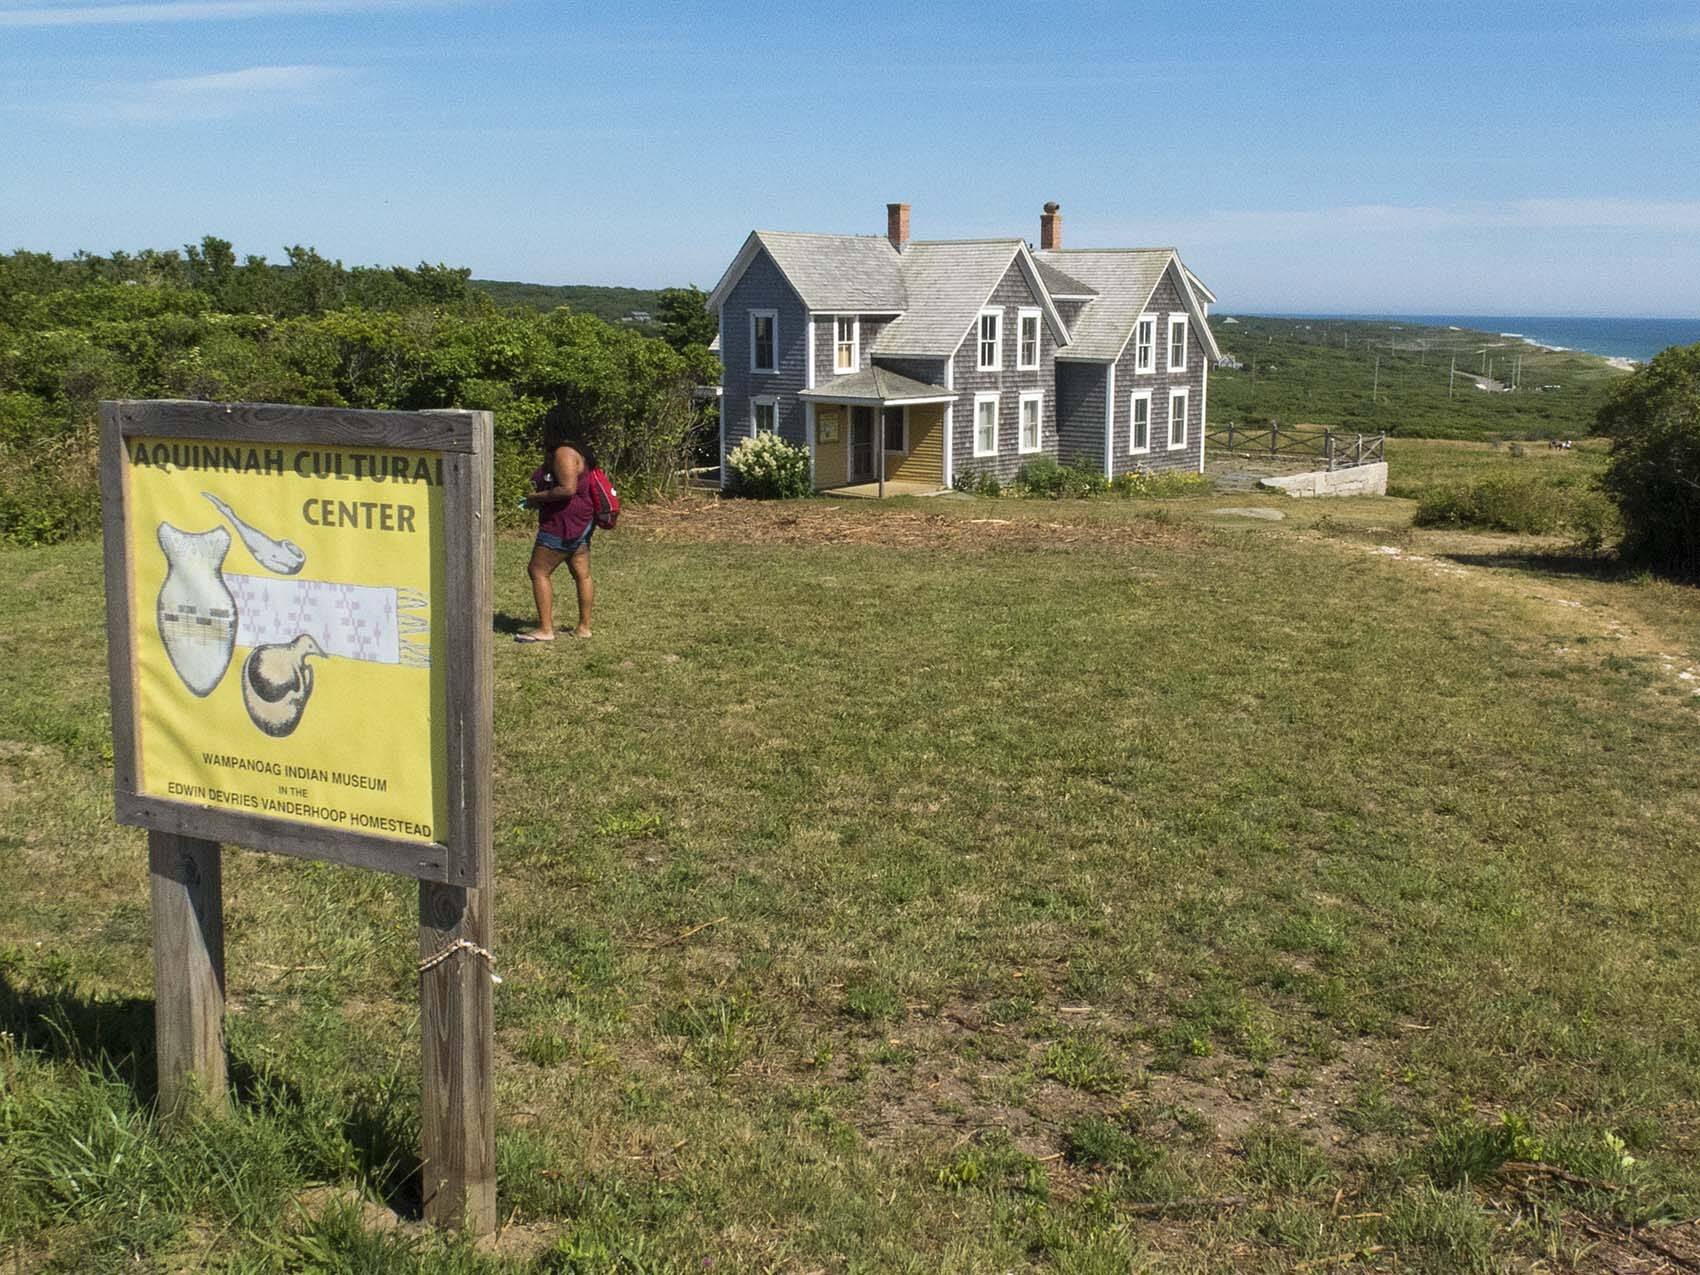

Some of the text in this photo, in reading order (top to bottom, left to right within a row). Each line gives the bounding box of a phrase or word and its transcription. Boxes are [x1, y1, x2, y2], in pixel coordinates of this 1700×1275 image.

[133, 442, 284, 477] AQUINNAH
[302, 498, 416, 533] CENTER
[202, 752, 388, 793] WAMPANOAG INDIAN MUSEUM
[278, 785, 308, 798] IN THE
[168, 782, 432, 838] EDWIN DEVRIES VANDERHOOP HOMESTEAD
